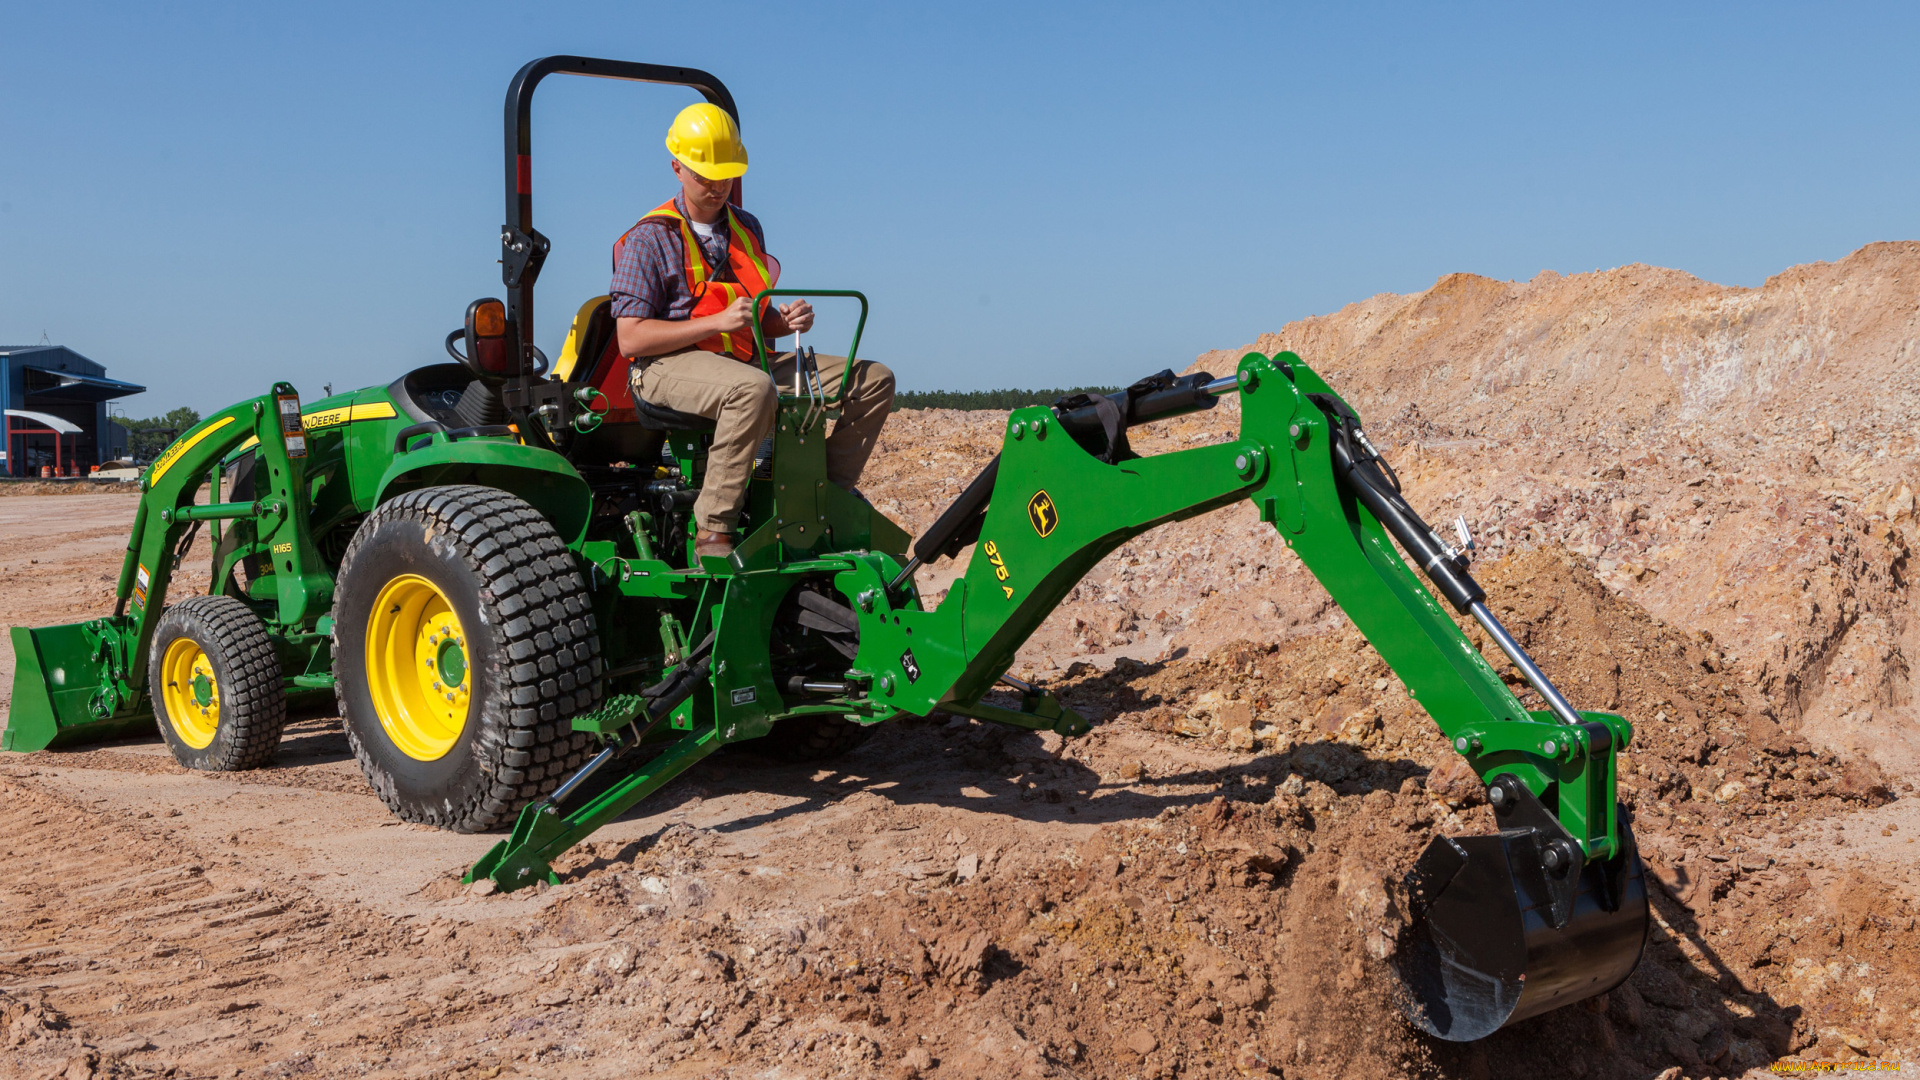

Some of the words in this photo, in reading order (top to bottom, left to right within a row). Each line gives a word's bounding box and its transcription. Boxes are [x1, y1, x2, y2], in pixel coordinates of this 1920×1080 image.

[311, 413, 341, 427] DEERE
[273, 542, 292, 554] H165
[260, 563, 275, 576] 304
[984, 540, 1010, 582] 375
[1001, 585, 1014, 601] A
